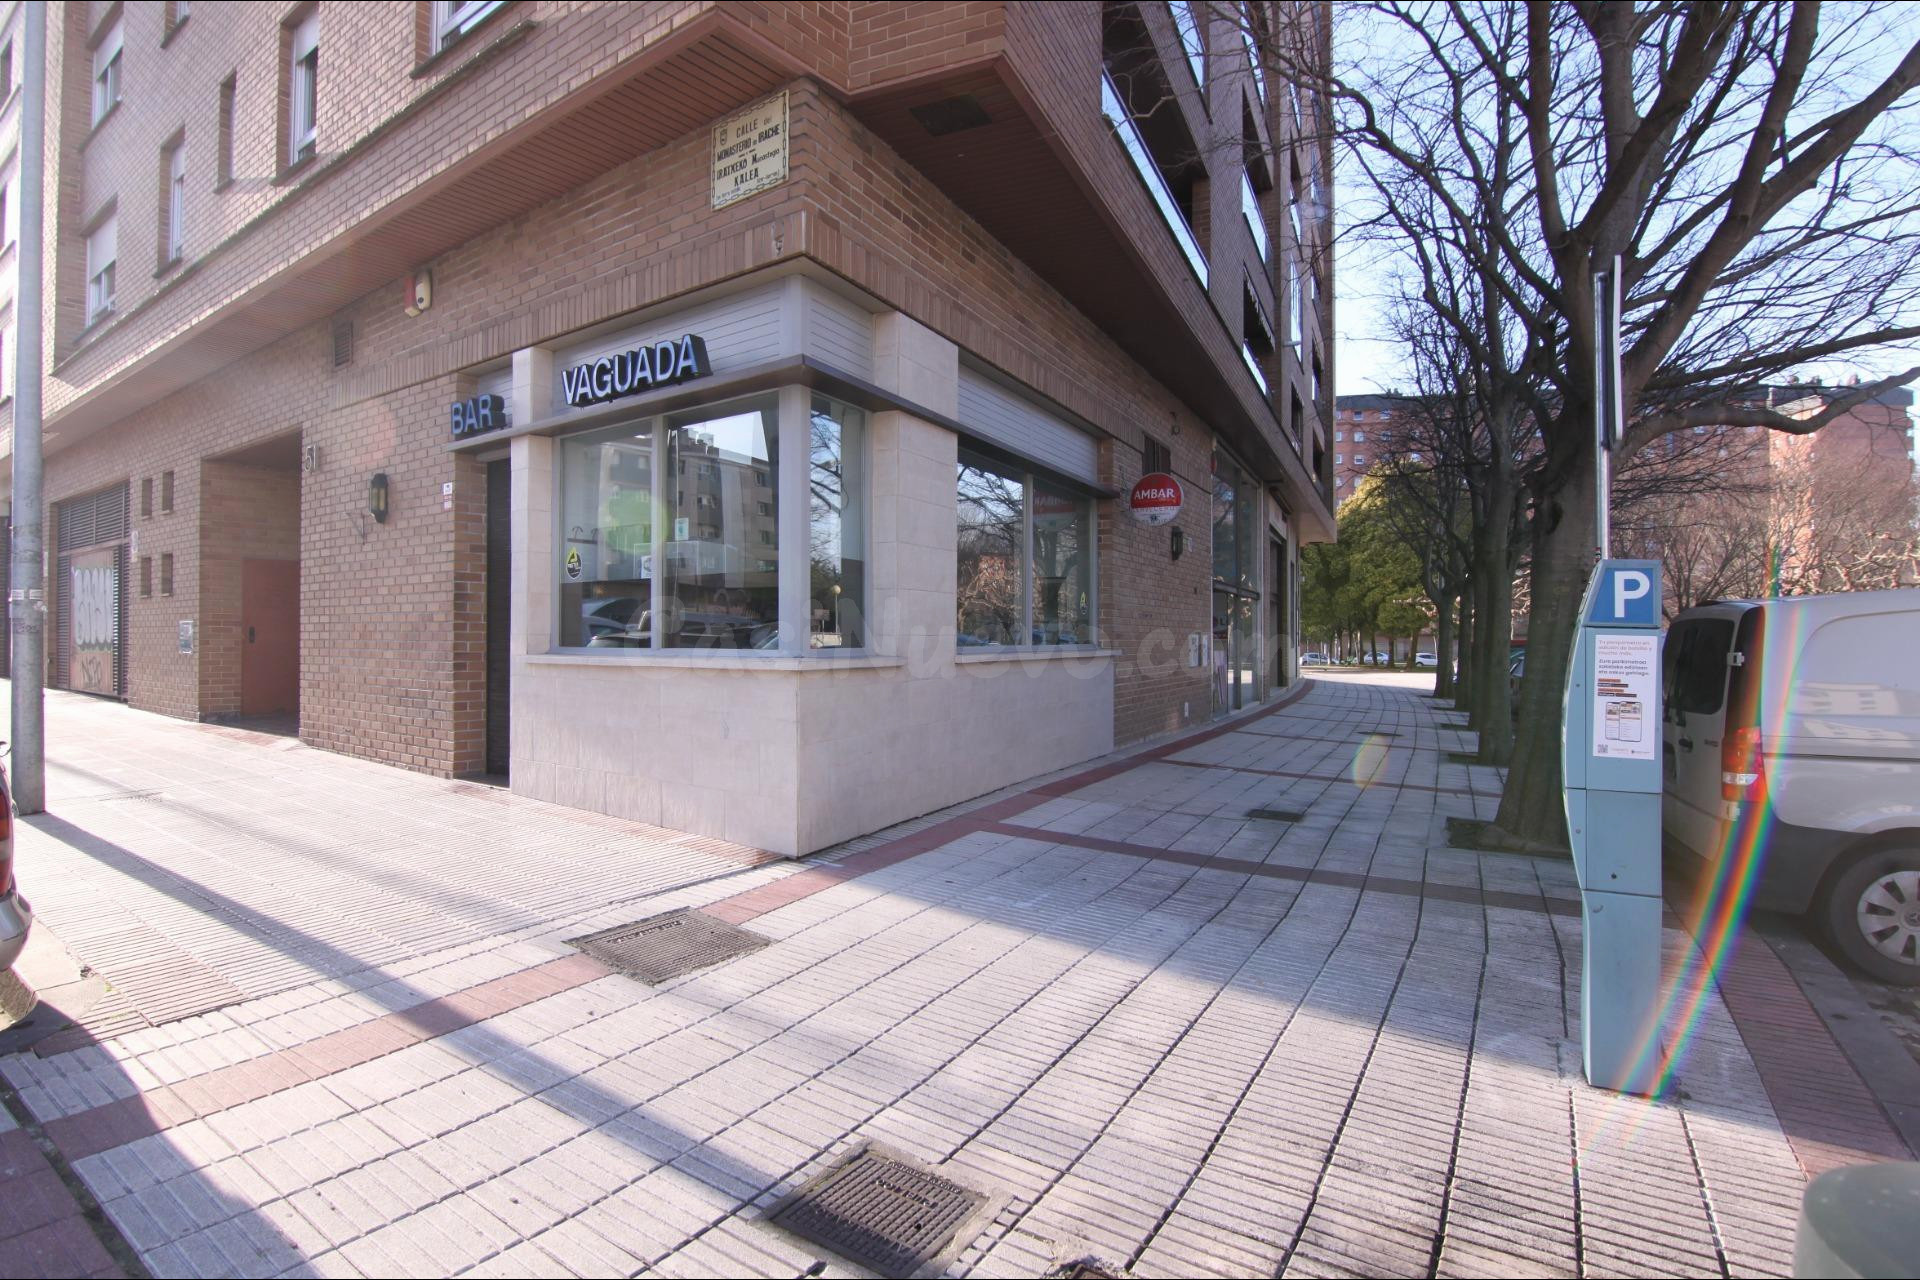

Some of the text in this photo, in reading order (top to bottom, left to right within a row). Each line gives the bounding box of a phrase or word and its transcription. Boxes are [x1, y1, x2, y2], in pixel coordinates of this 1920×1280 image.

[716, 137, 752, 162] MONASTERIO
[758, 123, 780, 143] IRACHE
[736, 118, 758, 138] CALLE
[716, 158, 748, 180] IRATXEKO
[734, 167, 759, 187] KALEA
[561, 333, 700, 406] VAGUADA
[451, 393, 495, 436] BAR
[1134, 488, 1176, 500] AMBAR
[1614, 570, 1650, 618] P
